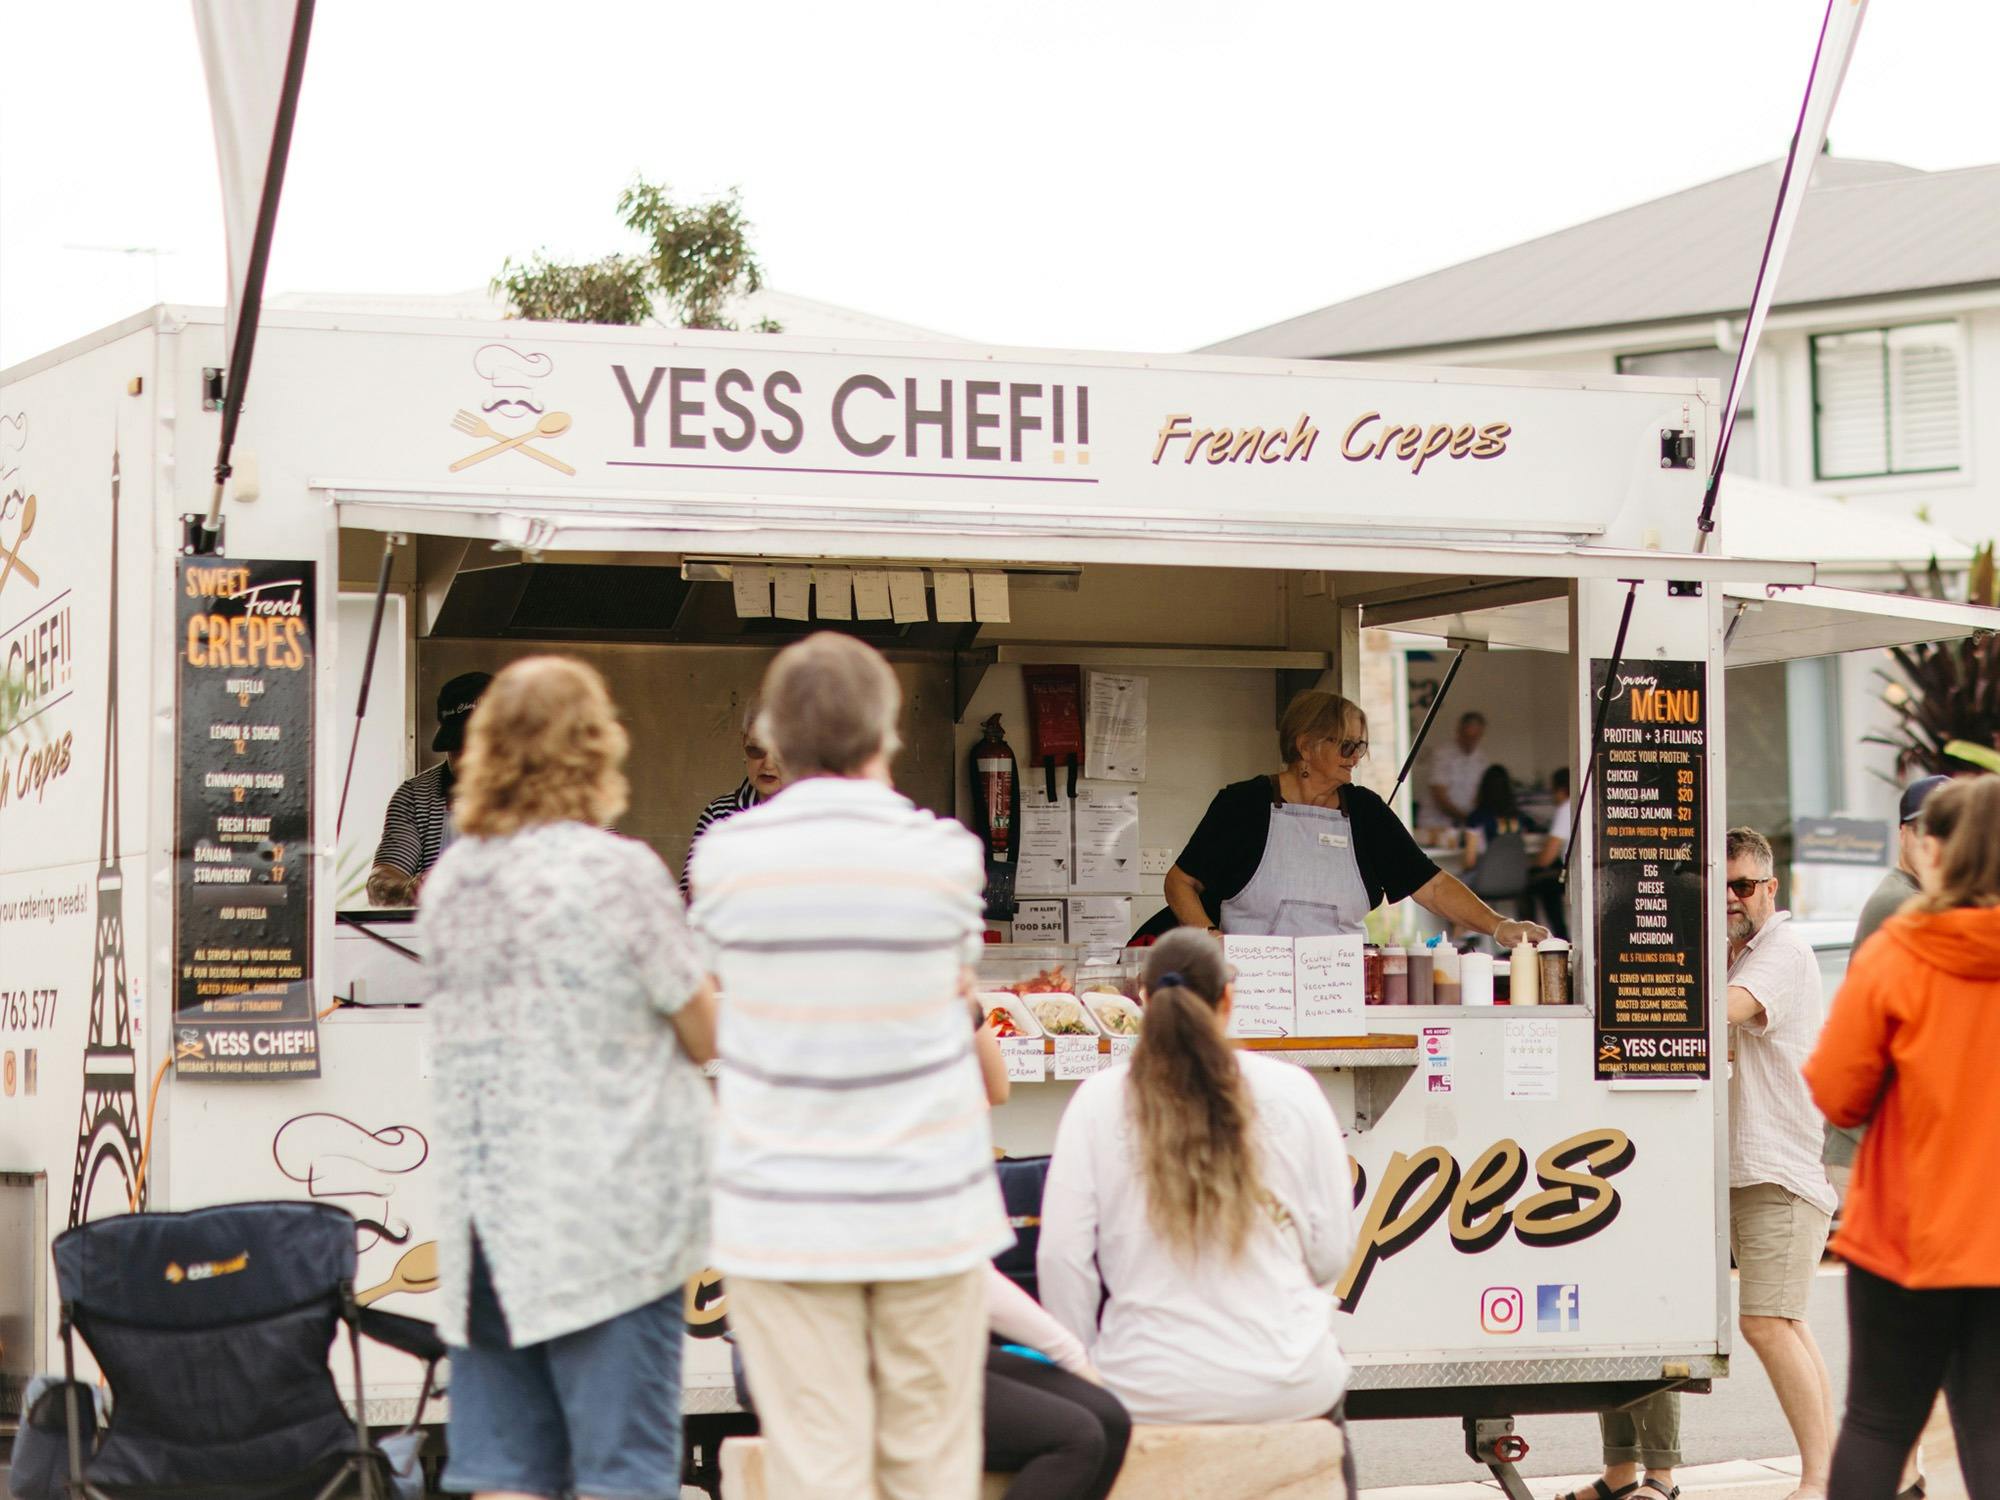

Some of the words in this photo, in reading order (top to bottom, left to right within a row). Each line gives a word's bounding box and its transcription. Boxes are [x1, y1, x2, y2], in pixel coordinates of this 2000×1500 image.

[611, 365, 804, 454] YESS
[831, 374, 1090, 465] CHEF!!
[1152, 411, 1320, 465] French
[1341, 410, 1512, 475] Crepes
[186, 566, 250, 599] SWEET
[229, 580, 302, 631] French
[187, 613, 306, 671] CREPES
[226, 678, 264, 693] NUTELLA
[1631, 688, 1699, 724] MENU
[210, 725, 241, 740] LEMON
[242, 725, 250, 740] &
[252, 725, 280, 741] SUGAR
[1604, 728, 1642, 743] PROTEIN
[1645, 733, 1652, 741] +
[1654, 729, 1661, 744] 3
[1663, 729, 1703, 745] FILLINGS
[1609, 749, 1637, 762] CHOOSE
[1638, 750, 1657, 763] YOUR
[1660, 750, 1690, 763] PROTEIN:
[16, 730, 72, 804] Crepes
[205, 772, 254, 788] CINNAMON
[255, 773, 284, 789] SUGAR
[1606, 769, 1638, 782] CHICKEN
[1677, 769, 1693, 784] $20
[1607, 788, 1638, 800] SMOKED
[1641, 788, 1659, 800] HAM
[1678, 788, 1693, 802] $20
[1607, 806, 1639, 820] SMOKED
[1641, 807, 1672, 820] SALMON
[1678, 807, 1691, 821] $21
[217, 816, 244, 832] FRESH
[246, 816, 271, 832] FRUIT
[194, 846, 232, 862] BANANA
[1609, 848, 1637, 860] CHOOSE
[1638, 848, 1657, 860] YOUR
[194, 866, 252, 883] STRAWBERRY
[1643, 864, 1658, 877] EGG
[1638, 881, 1665, 894] CHEESE
[19, 890, 55, 925] catering
[1635, 898, 1667, 911] SPINACH
[220, 907, 235, 920] ADD
[236, 907, 267, 920] NUTELLA
[1636, 915, 1667, 928] TOMATO
[1015, 923, 1039, 931] FOOD
[1629, 932, 1674, 945] MUSHROOM
[1, 990, 28, 1032] 763
[31, 988, 58, 1031] 577
[1305, 1007, 1353, 1017] AVAILABLE
[1505, 1022, 1526, 1037] Eat
[1528, 1021, 1557, 1037] Safe
[206, 1030, 250, 1056] YESS
[253, 1029, 315, 1056] CHEF!!
[1622, 1038, 1656, 1057] YESS
[1659, 1038, 1706, 1057] CHEF!!
[1333, 1128, 1636, 1315] pes
